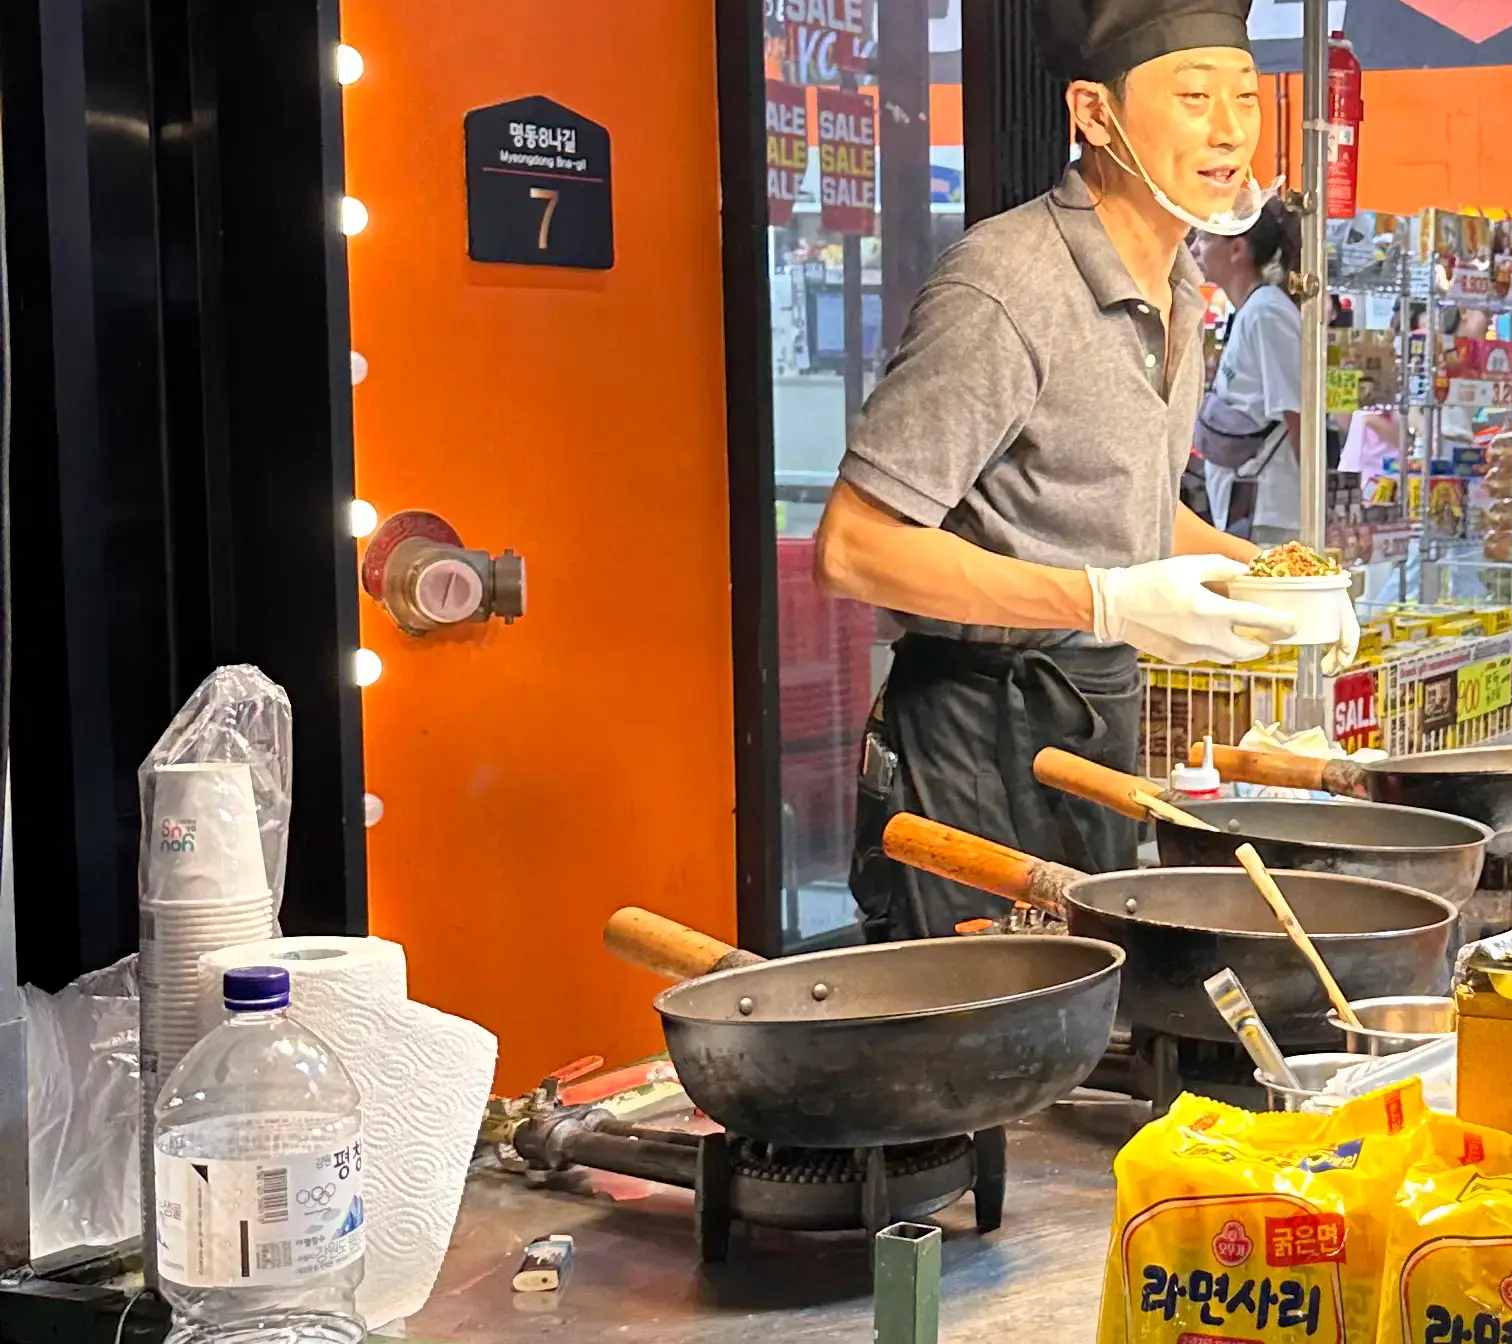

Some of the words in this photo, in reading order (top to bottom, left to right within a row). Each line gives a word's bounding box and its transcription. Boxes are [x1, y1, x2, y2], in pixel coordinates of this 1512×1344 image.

[766, 100, 805, 135] ALE
[819, 110, 874, 143] SALE
[767, 135, 806, 168] ALE
[820, 142, 874, 176] SALE
[767, 167, 806, 200] ALE
[822, 175, 875, 207] SALE
[530, 187, 559, 249] 7
[1273, 1224, 1340, 1256] 굵은면
[1141, 1264, 1321, 1336] 라면사리
